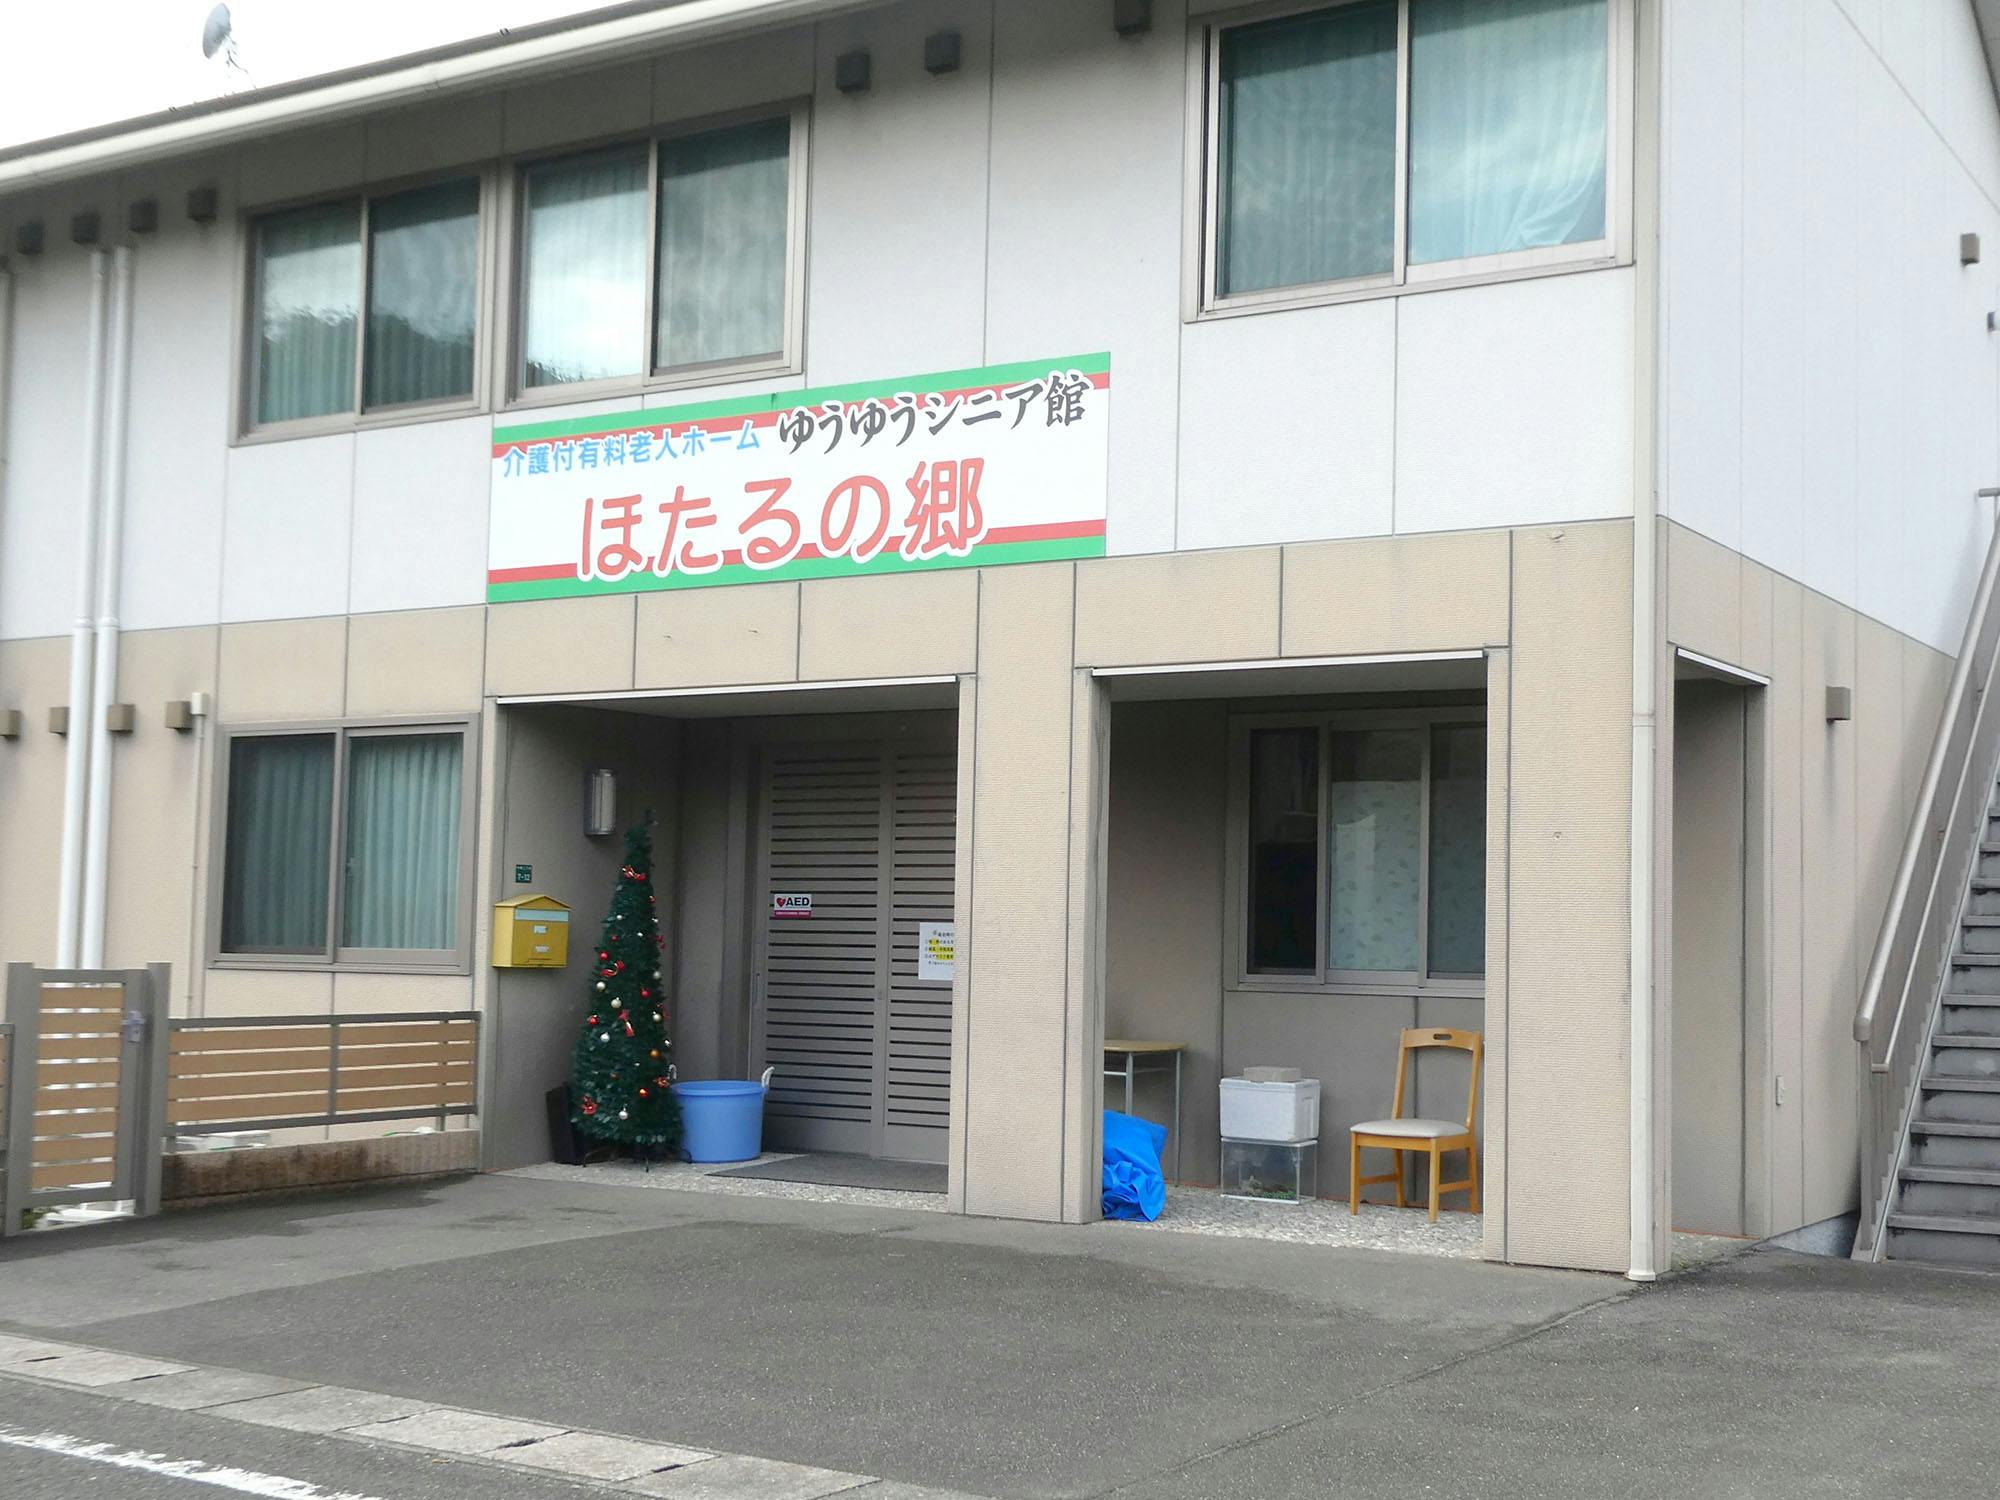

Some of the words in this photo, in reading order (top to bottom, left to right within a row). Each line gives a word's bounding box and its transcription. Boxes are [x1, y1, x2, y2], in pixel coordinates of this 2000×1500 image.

[780, 374, 1090, 455] ゆうゆうシニア館
[504, 422, 760, 477] 介護付有料老人ホーム
[580, 457, 985, 576] ほたるの郷
[786, 897, 810, 906] AED
